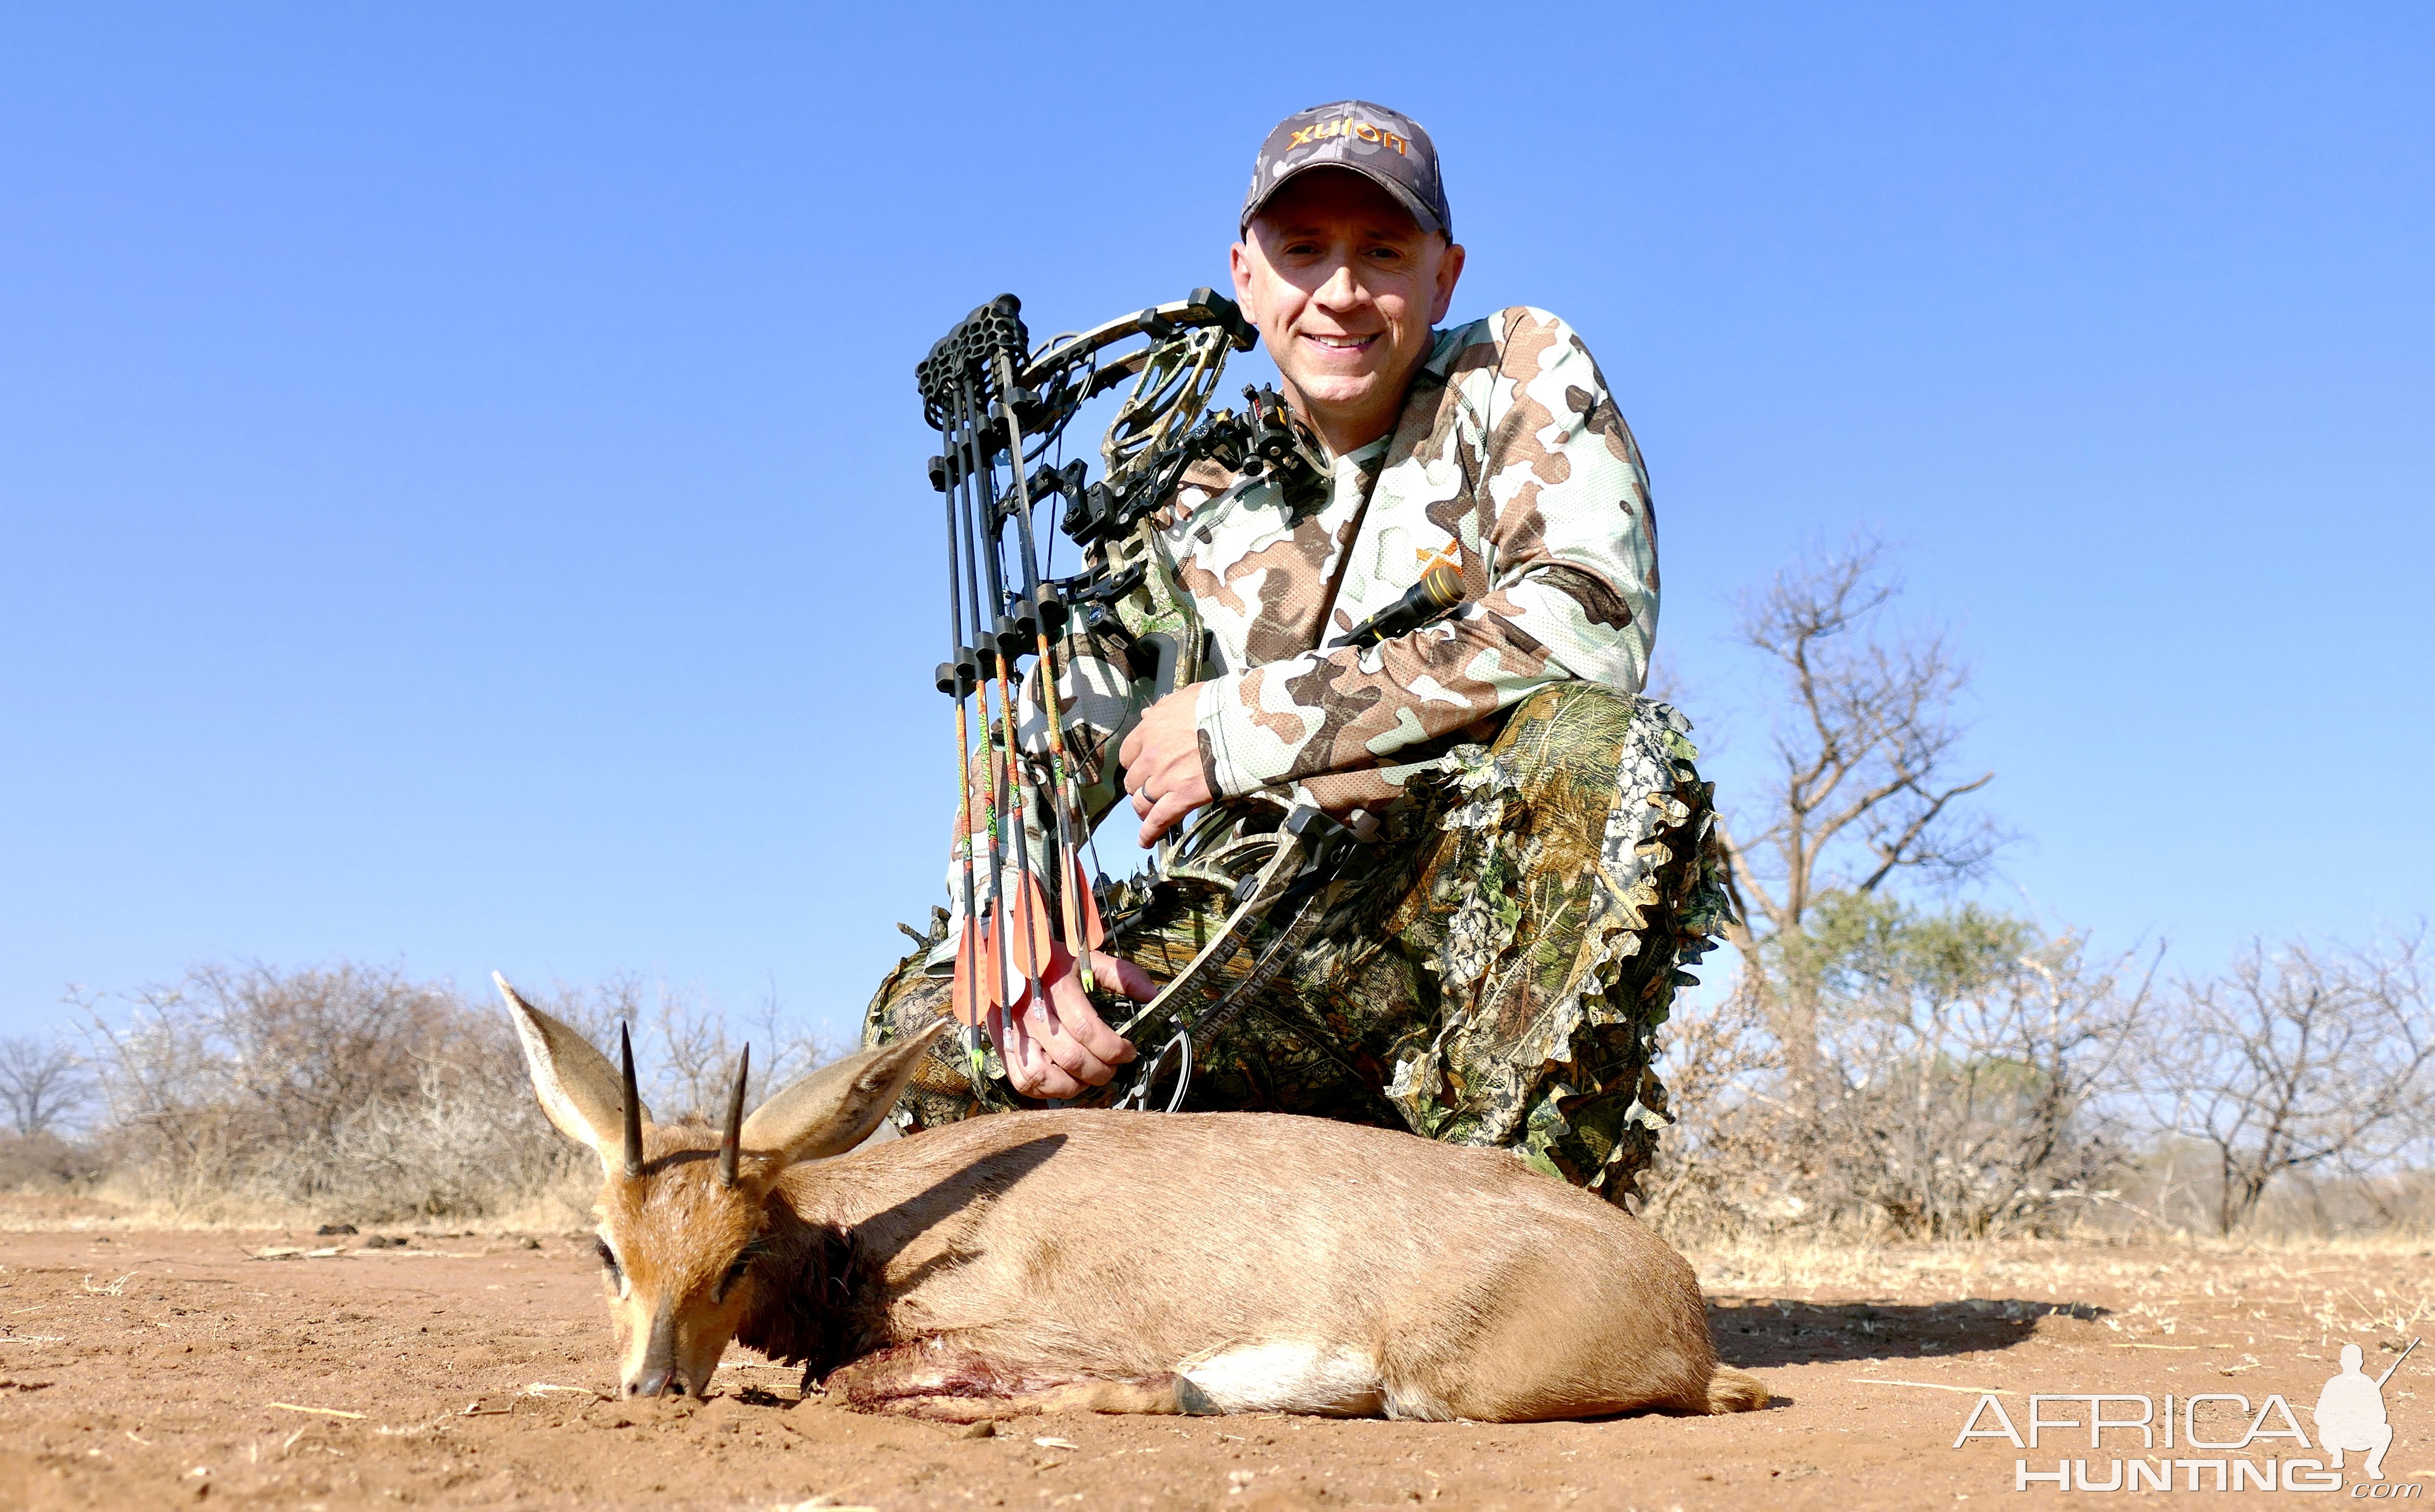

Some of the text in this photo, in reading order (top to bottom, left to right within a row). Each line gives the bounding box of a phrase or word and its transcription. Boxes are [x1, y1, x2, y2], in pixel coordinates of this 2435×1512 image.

[1152, 936, 1241, 1023] BEAR ARCHERY
[1191, 961, 1279, 1047] BEAR ARCHERY
